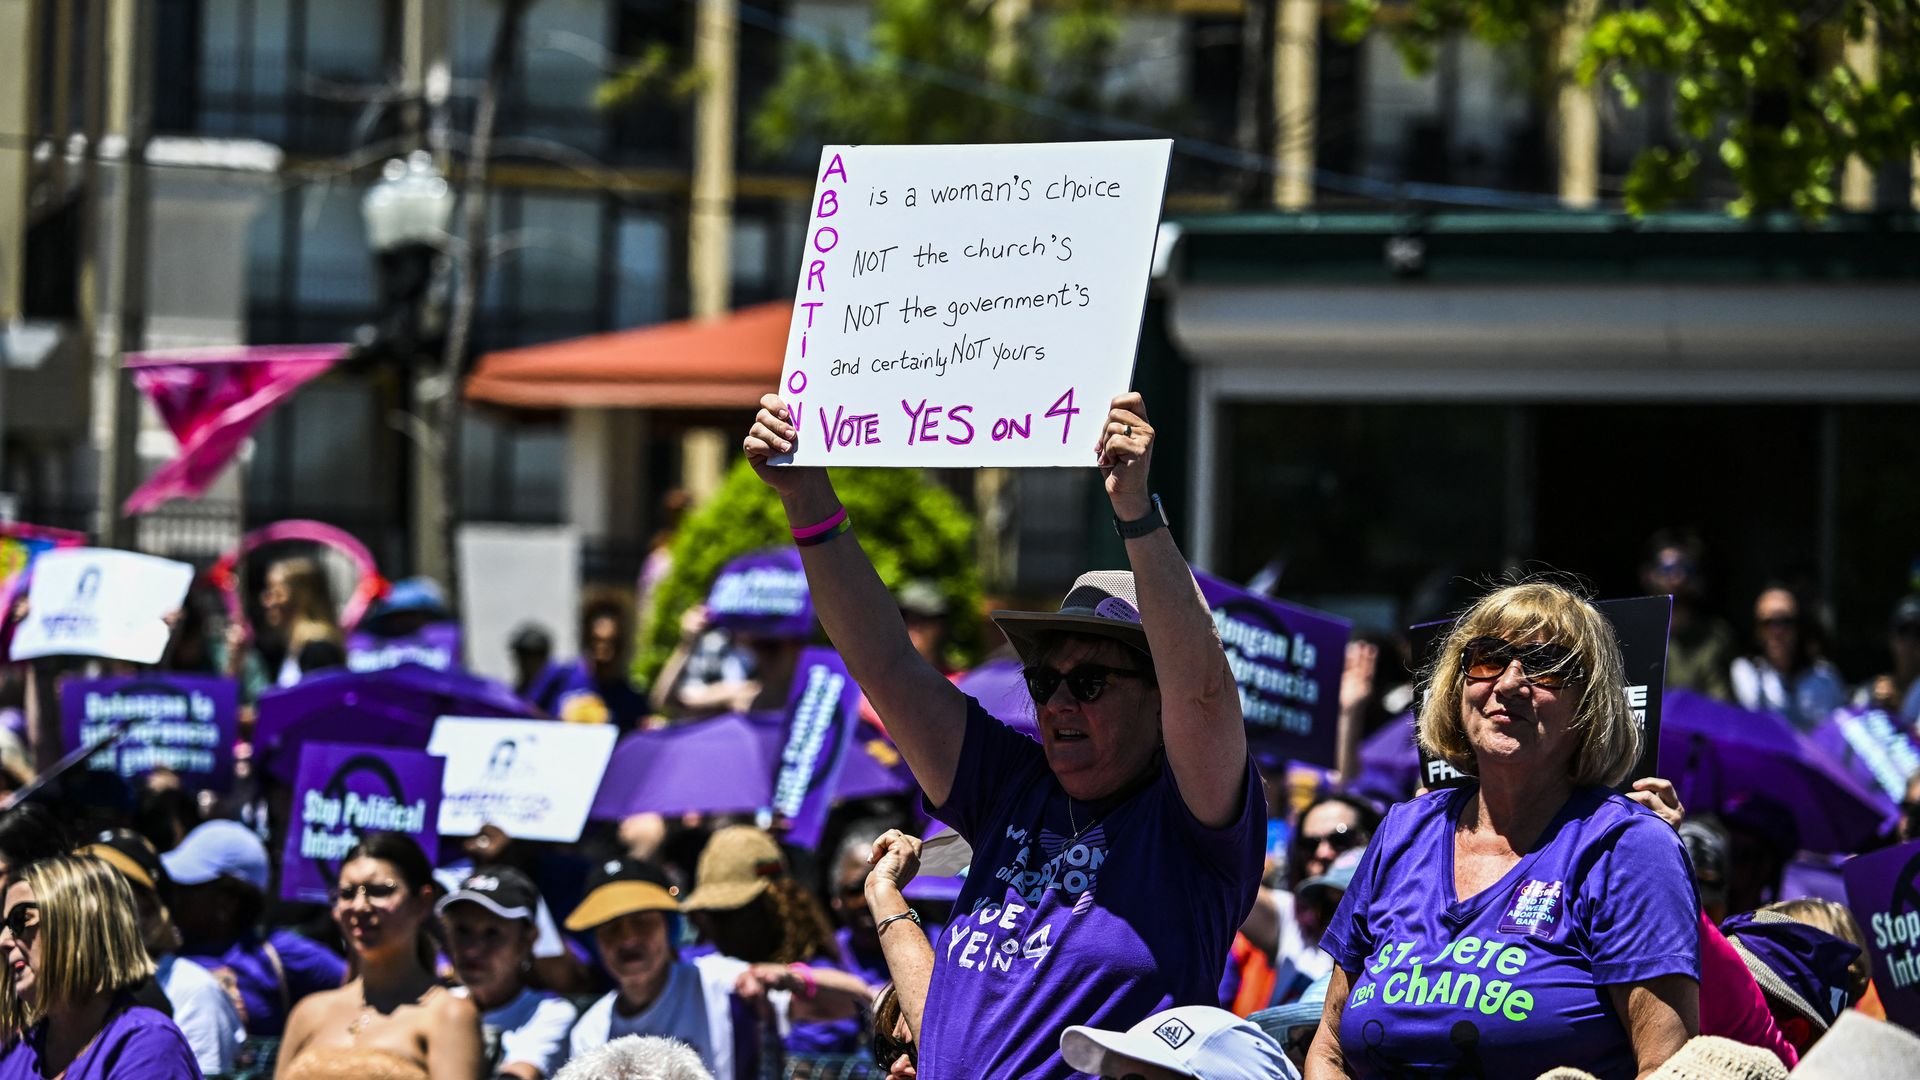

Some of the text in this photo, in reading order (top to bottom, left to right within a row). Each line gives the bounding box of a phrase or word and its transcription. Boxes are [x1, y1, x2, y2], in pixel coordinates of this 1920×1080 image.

[869, 174, 1121, 208] is a woman's choice
[852, 233, 1073, 278] NOT the church's
[843, 282, 1090, 334] NOT the government's
[830, 333, 1046, 377] and certainly NOT yours
[819, 386, 1080, 454] VOTE YES ON 4
[1022, 923, 1052, 970] 4
